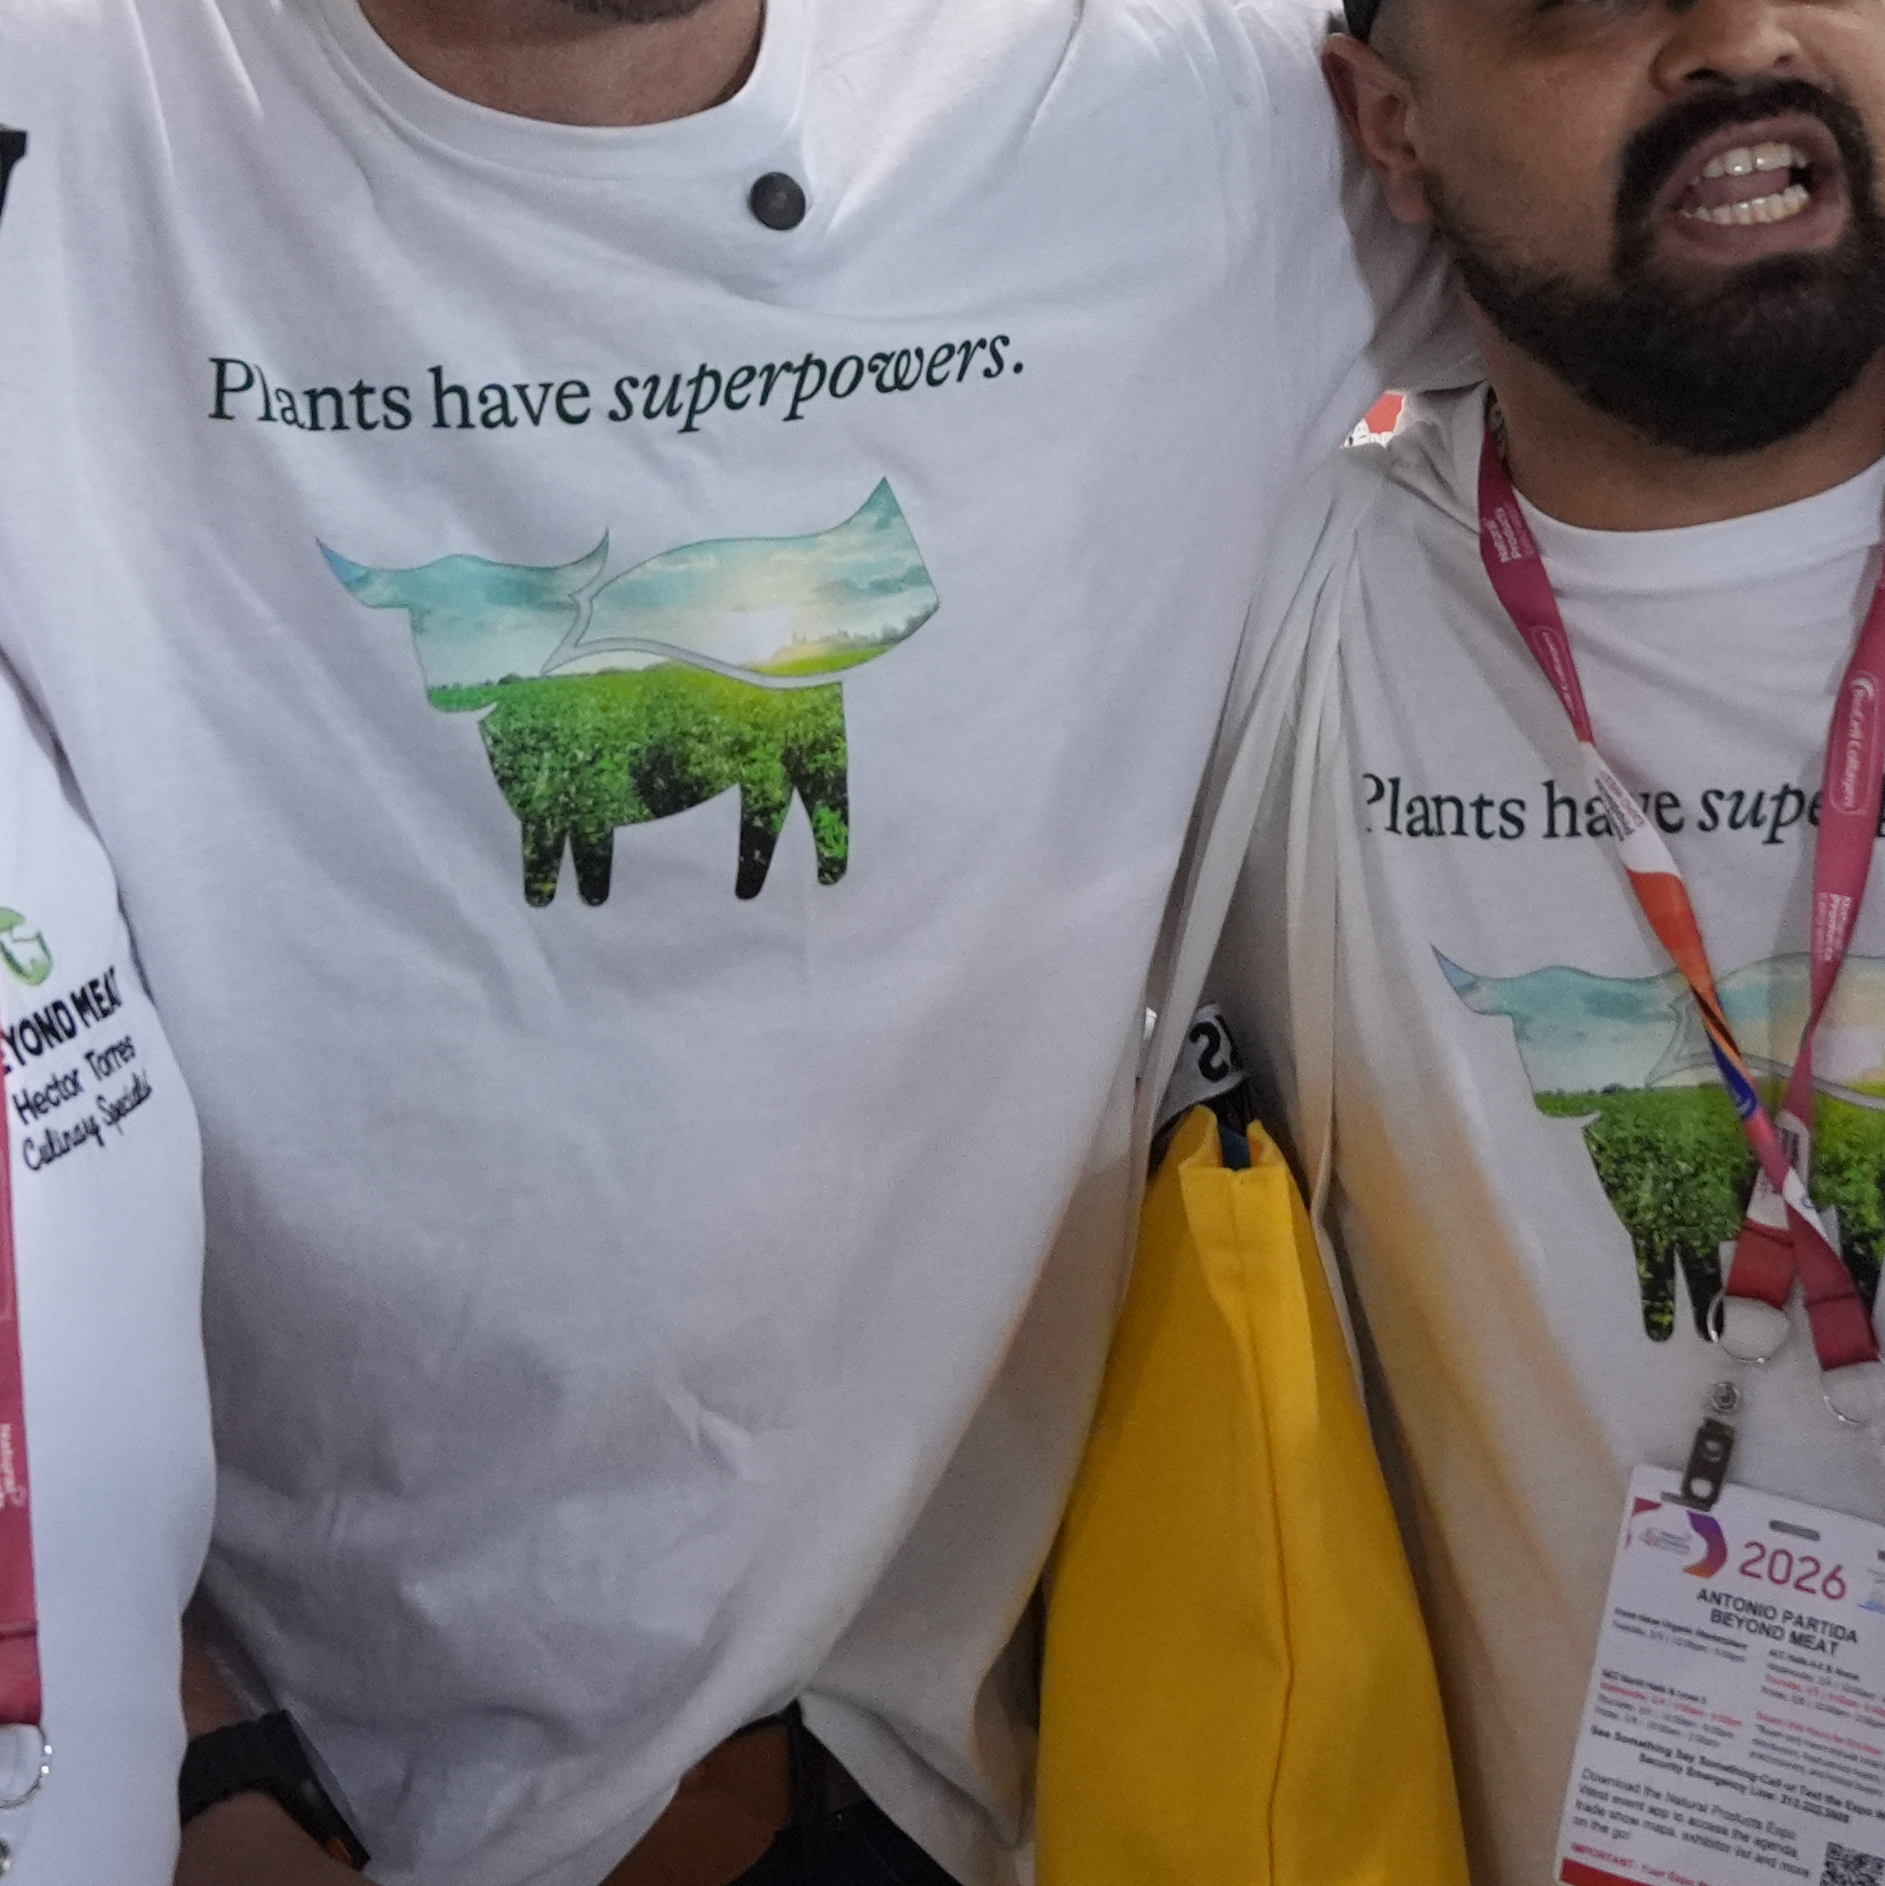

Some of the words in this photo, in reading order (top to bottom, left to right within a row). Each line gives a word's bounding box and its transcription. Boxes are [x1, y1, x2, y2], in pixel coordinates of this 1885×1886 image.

[209, 357, 413, 432] Plants
[431, 364, 592, 431] have
[609, 334, 1026, 434] superpowers.
[1480, 514, 1513, 565] Natural
[1490, 506, 1525, 560] Products
[1840, 740, 1862, 808] Collagen
[1542, 780, 1684, 840] hae
[0, 999, 77, 1074] YOND
[13, 1068, 84, 1126] Hector
[84, 1034, 137, 1081] Torres
[22, 1115, 105, 1172] Culinary
[0, 1423, 14, 1492] Natural
[1740, 1541, 1846, 1599] 2026
[1697, 1588, 1777, 1621] ANTONIO
[1782, 1610, 1857, 1643] PARTIDA
[1710, 1609, 1785, 1639] BEYOND
[1788, 1629, 1838, 1656] MEAT
